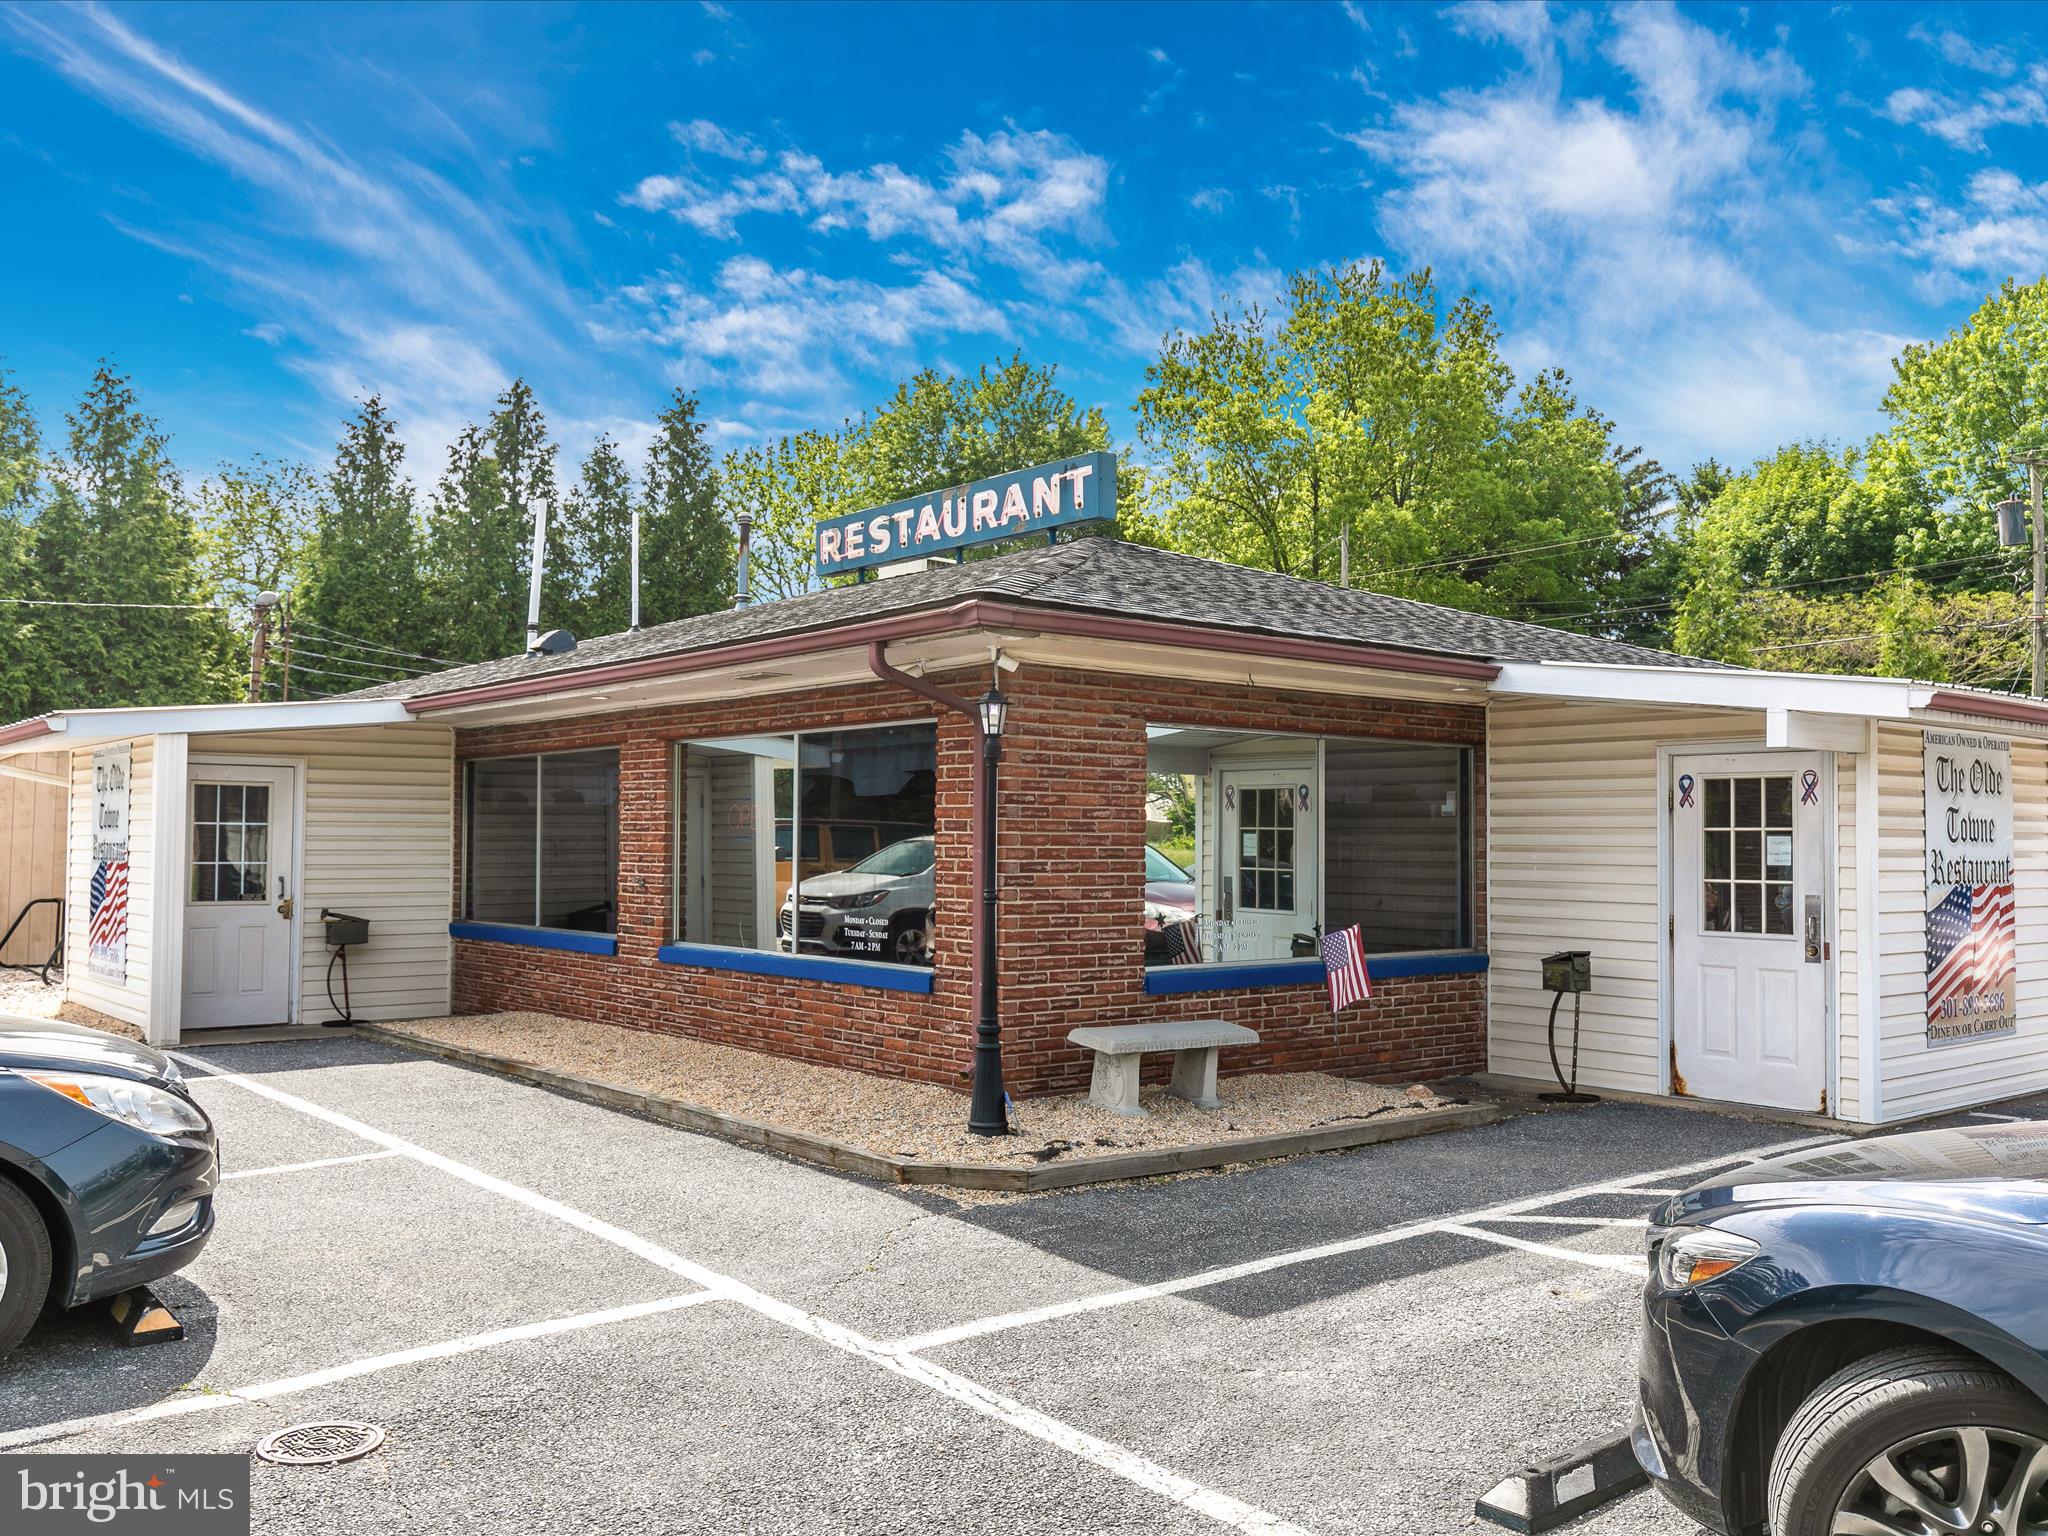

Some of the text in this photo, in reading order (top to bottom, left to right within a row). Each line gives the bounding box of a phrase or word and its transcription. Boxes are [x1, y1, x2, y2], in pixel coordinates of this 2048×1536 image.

[819, 465, 1093, 565] RESTAURANT
[1936, 755, 2003, 800] The Olde
[1946, 806, 1995, 843] Towne
[1931, 849, 2010, 886] Restaurant
[1930, 1024, 1951, 1040] DINE
[1974, 1018, 1998, 1033] CARRY
